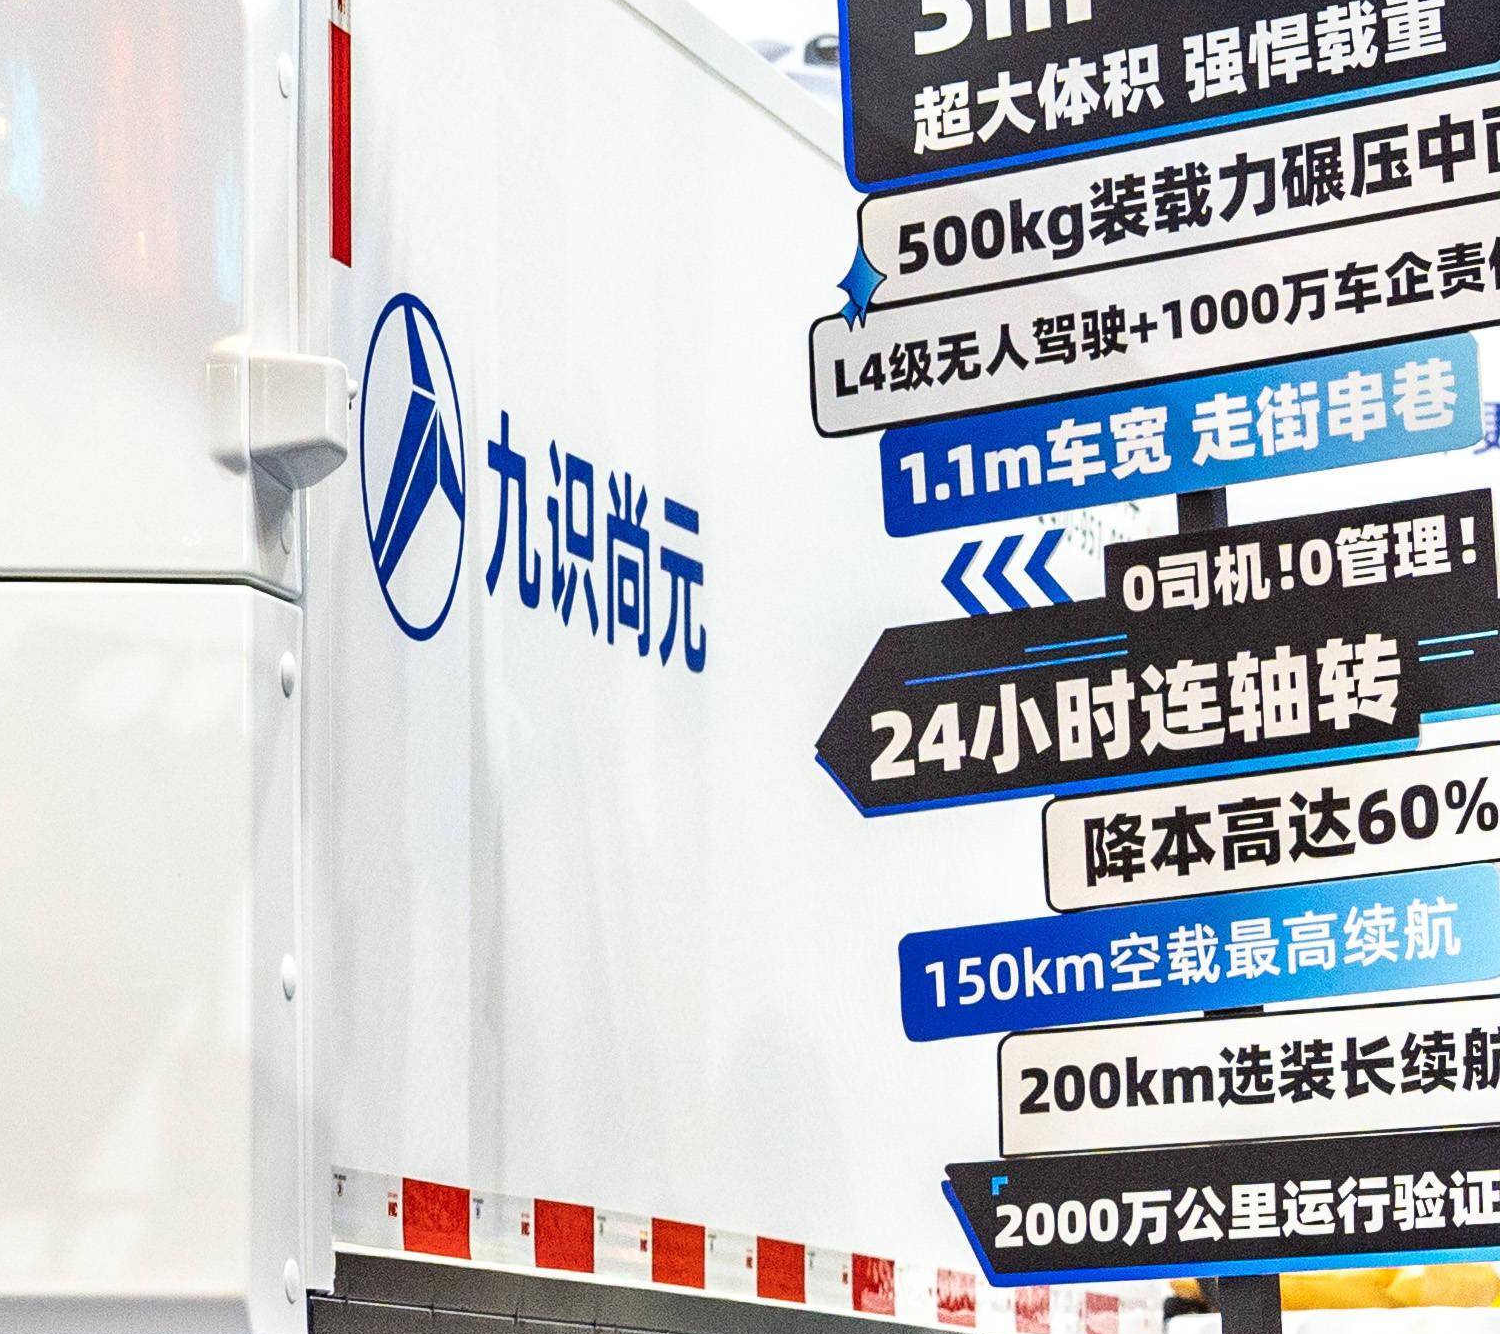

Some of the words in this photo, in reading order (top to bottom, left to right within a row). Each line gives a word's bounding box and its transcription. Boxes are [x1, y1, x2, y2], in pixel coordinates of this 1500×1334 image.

[913, 44, 1160, 155] 超大体积
[833, 235, 1500, 399] L4级无人驾驶+1000万车企责
[899, 406, 1173, 506] 1.1m车宽
[1191, 358, 1458, 467] 走街串巷
[485, 410, 706, 674] 九识尚元
[869, 633, 1403, 781] 24小时连轴转
[1083, 777, 1499, 887] 降本高达60%
[924, 896, 1461, 1009] 150km空载最高续航
[1018, 1025, 1500, 1116] 200km选装长续航
[994, 1169, 1500, 1249] 2000万公里运行验证
